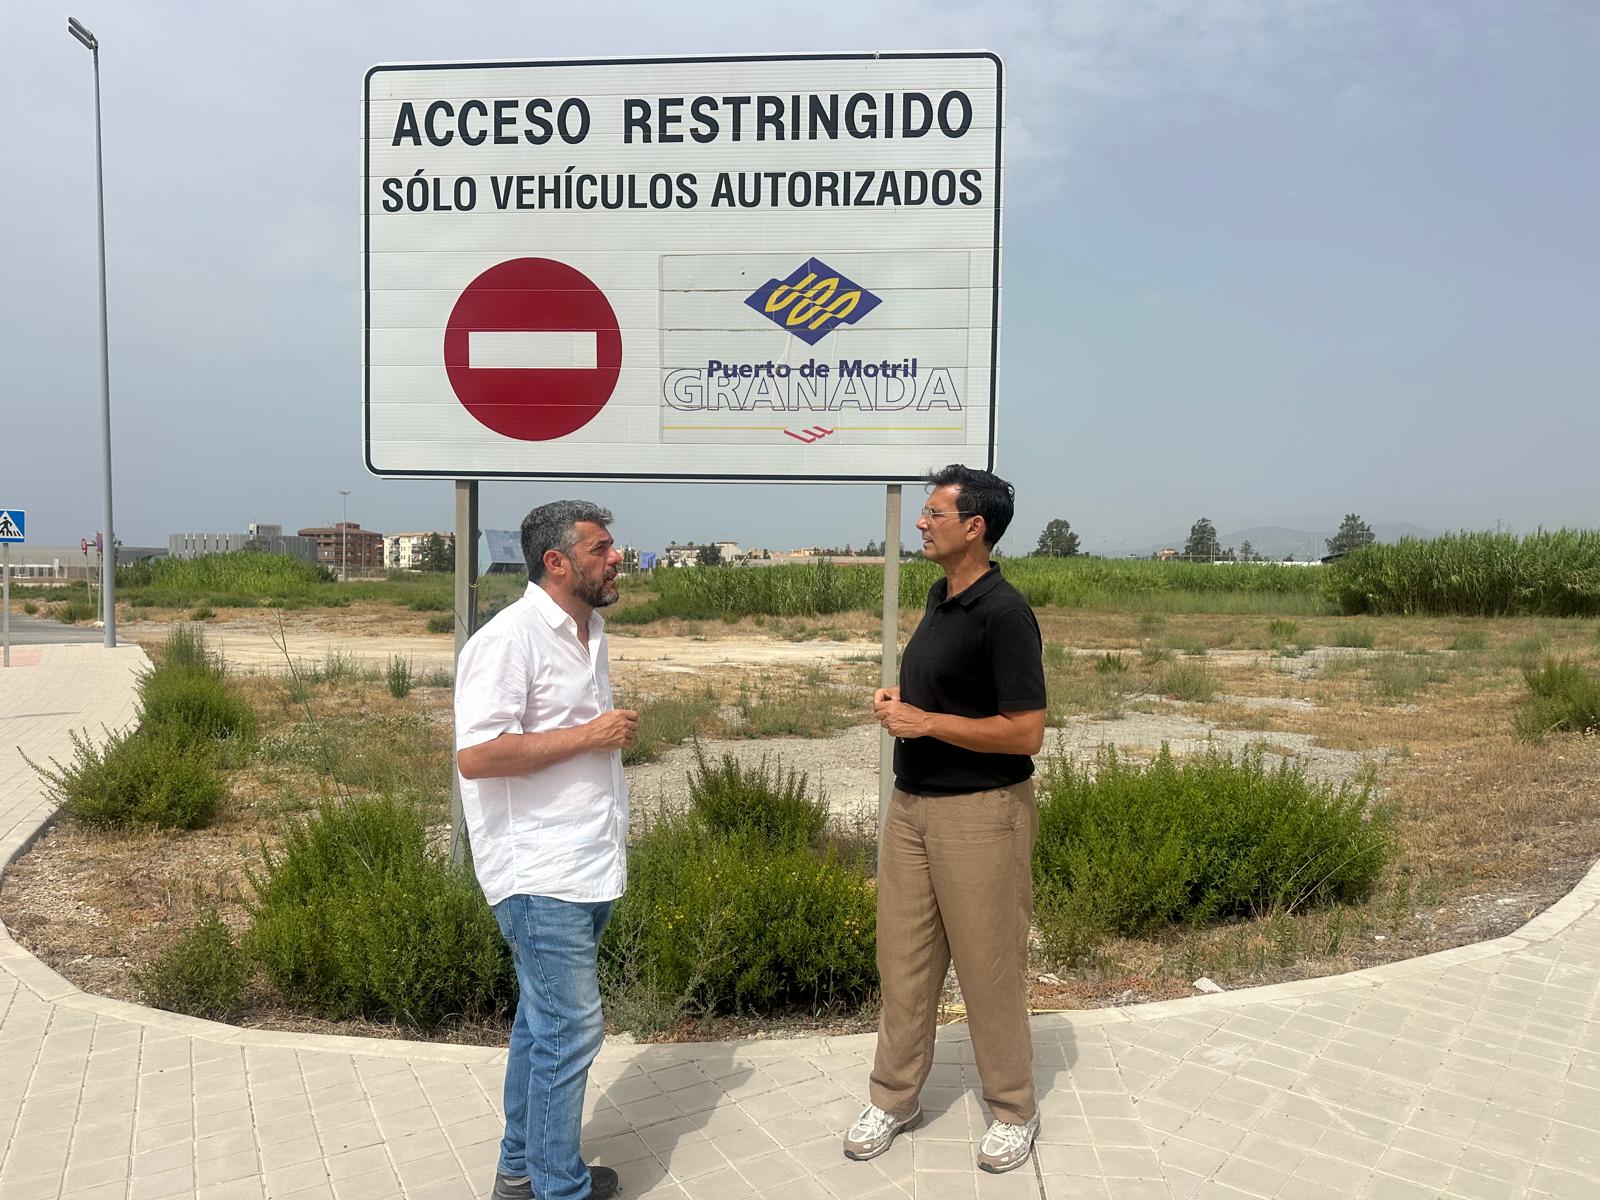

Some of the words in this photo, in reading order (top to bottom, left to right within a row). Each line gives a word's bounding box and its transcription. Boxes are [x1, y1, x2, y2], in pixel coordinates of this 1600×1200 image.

[391, 97, 591, 147] ACCESO
[623, 90, 974, 144] RESTRINGIDO
[382, 168, 477, 213] SÓLO
[490, 166, 698, 211] VEHÍCULOS
[710, 168, 983, 209] AUTORIZADOS
[663, 367, 962, 412] GRANADA
[707, 359, 791, 379] Puerto
[799, 359, 830, 379] de
[838, 358, 918, 379] Motril
